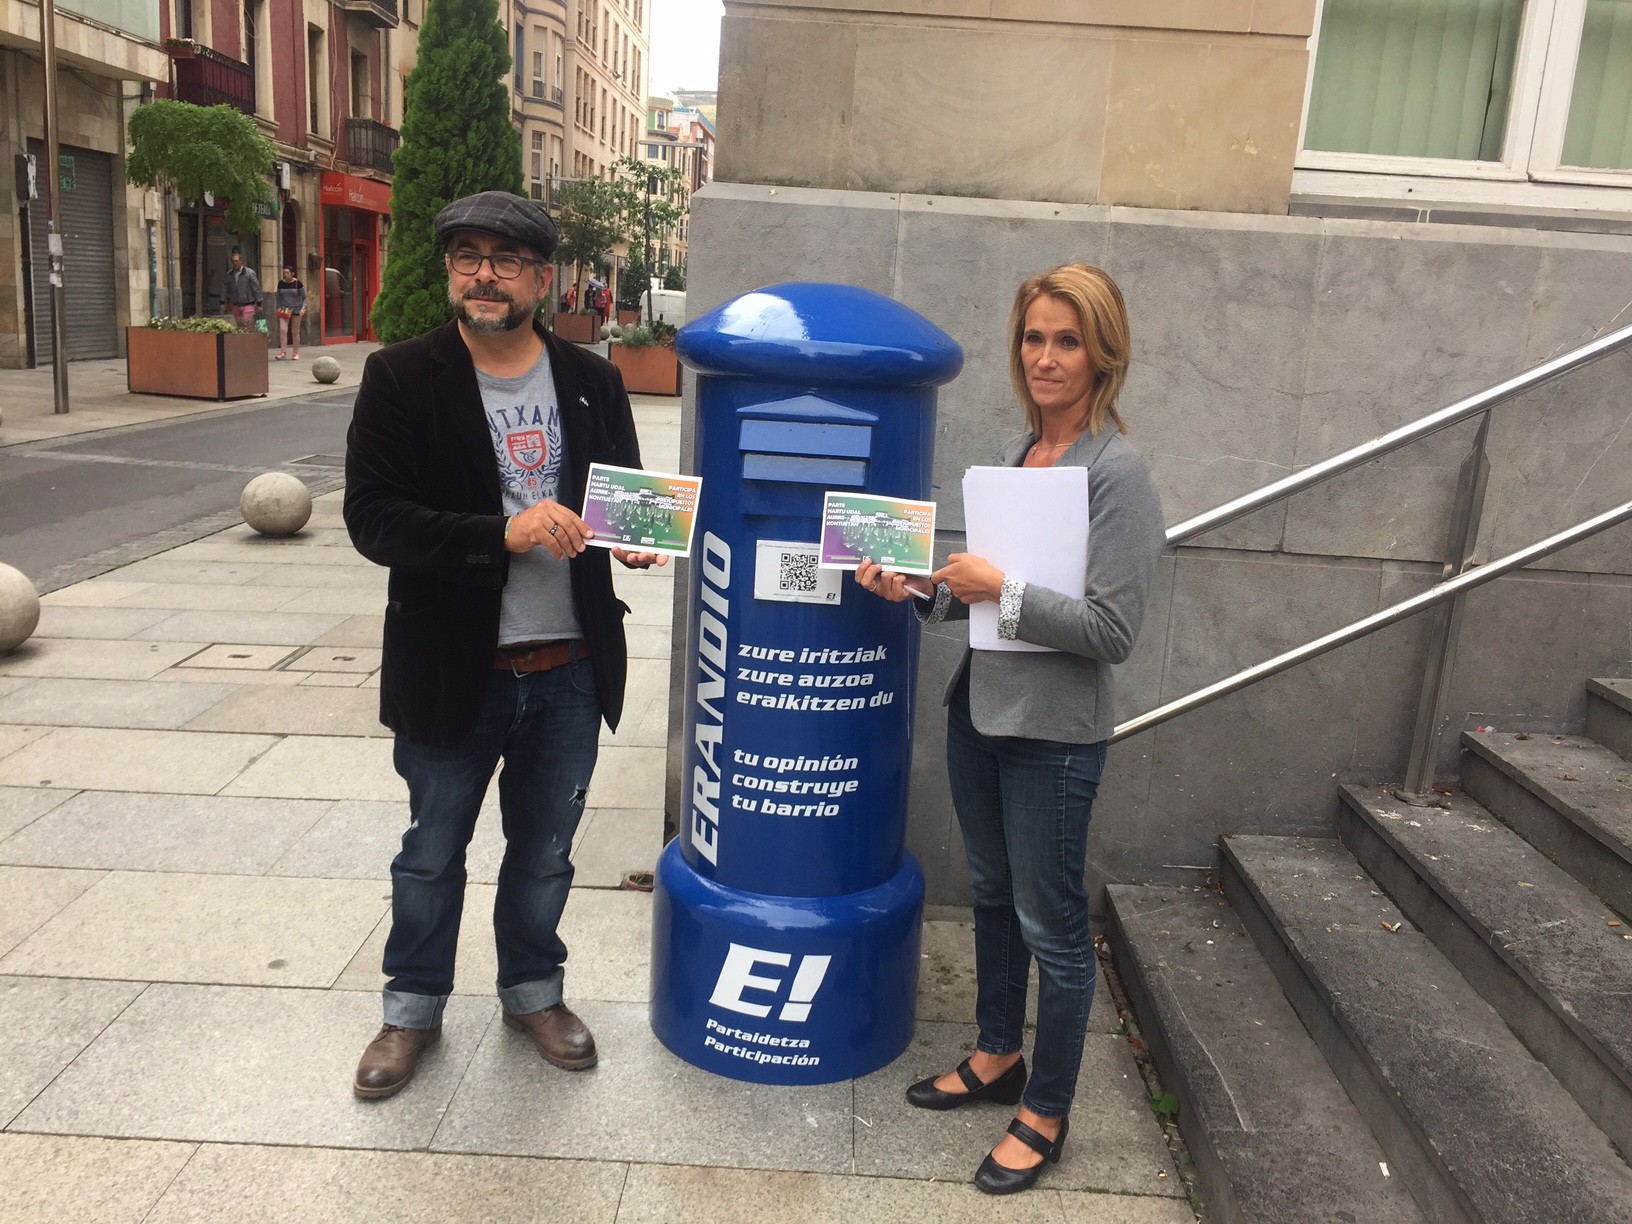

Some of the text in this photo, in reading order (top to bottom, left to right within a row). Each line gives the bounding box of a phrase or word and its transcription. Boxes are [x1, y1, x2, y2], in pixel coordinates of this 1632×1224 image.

[738, 644, 886, 663] zure iritziak
[737, 668, 873, 687] zure auzoa
[691, 531, 731, 867] ERANDIO
[737, 691, 893, 710] eraikitzen du
[734, 750, 858, 773] tu opinión
[732, 774, 858, 797] construye
[732, 795, 839, 816] tu barrio
[707, 943, 831, 1024] E!
[706, 1018, 810, 1048] Partaidetza
[705, 1035, 819, 1065] Participación
